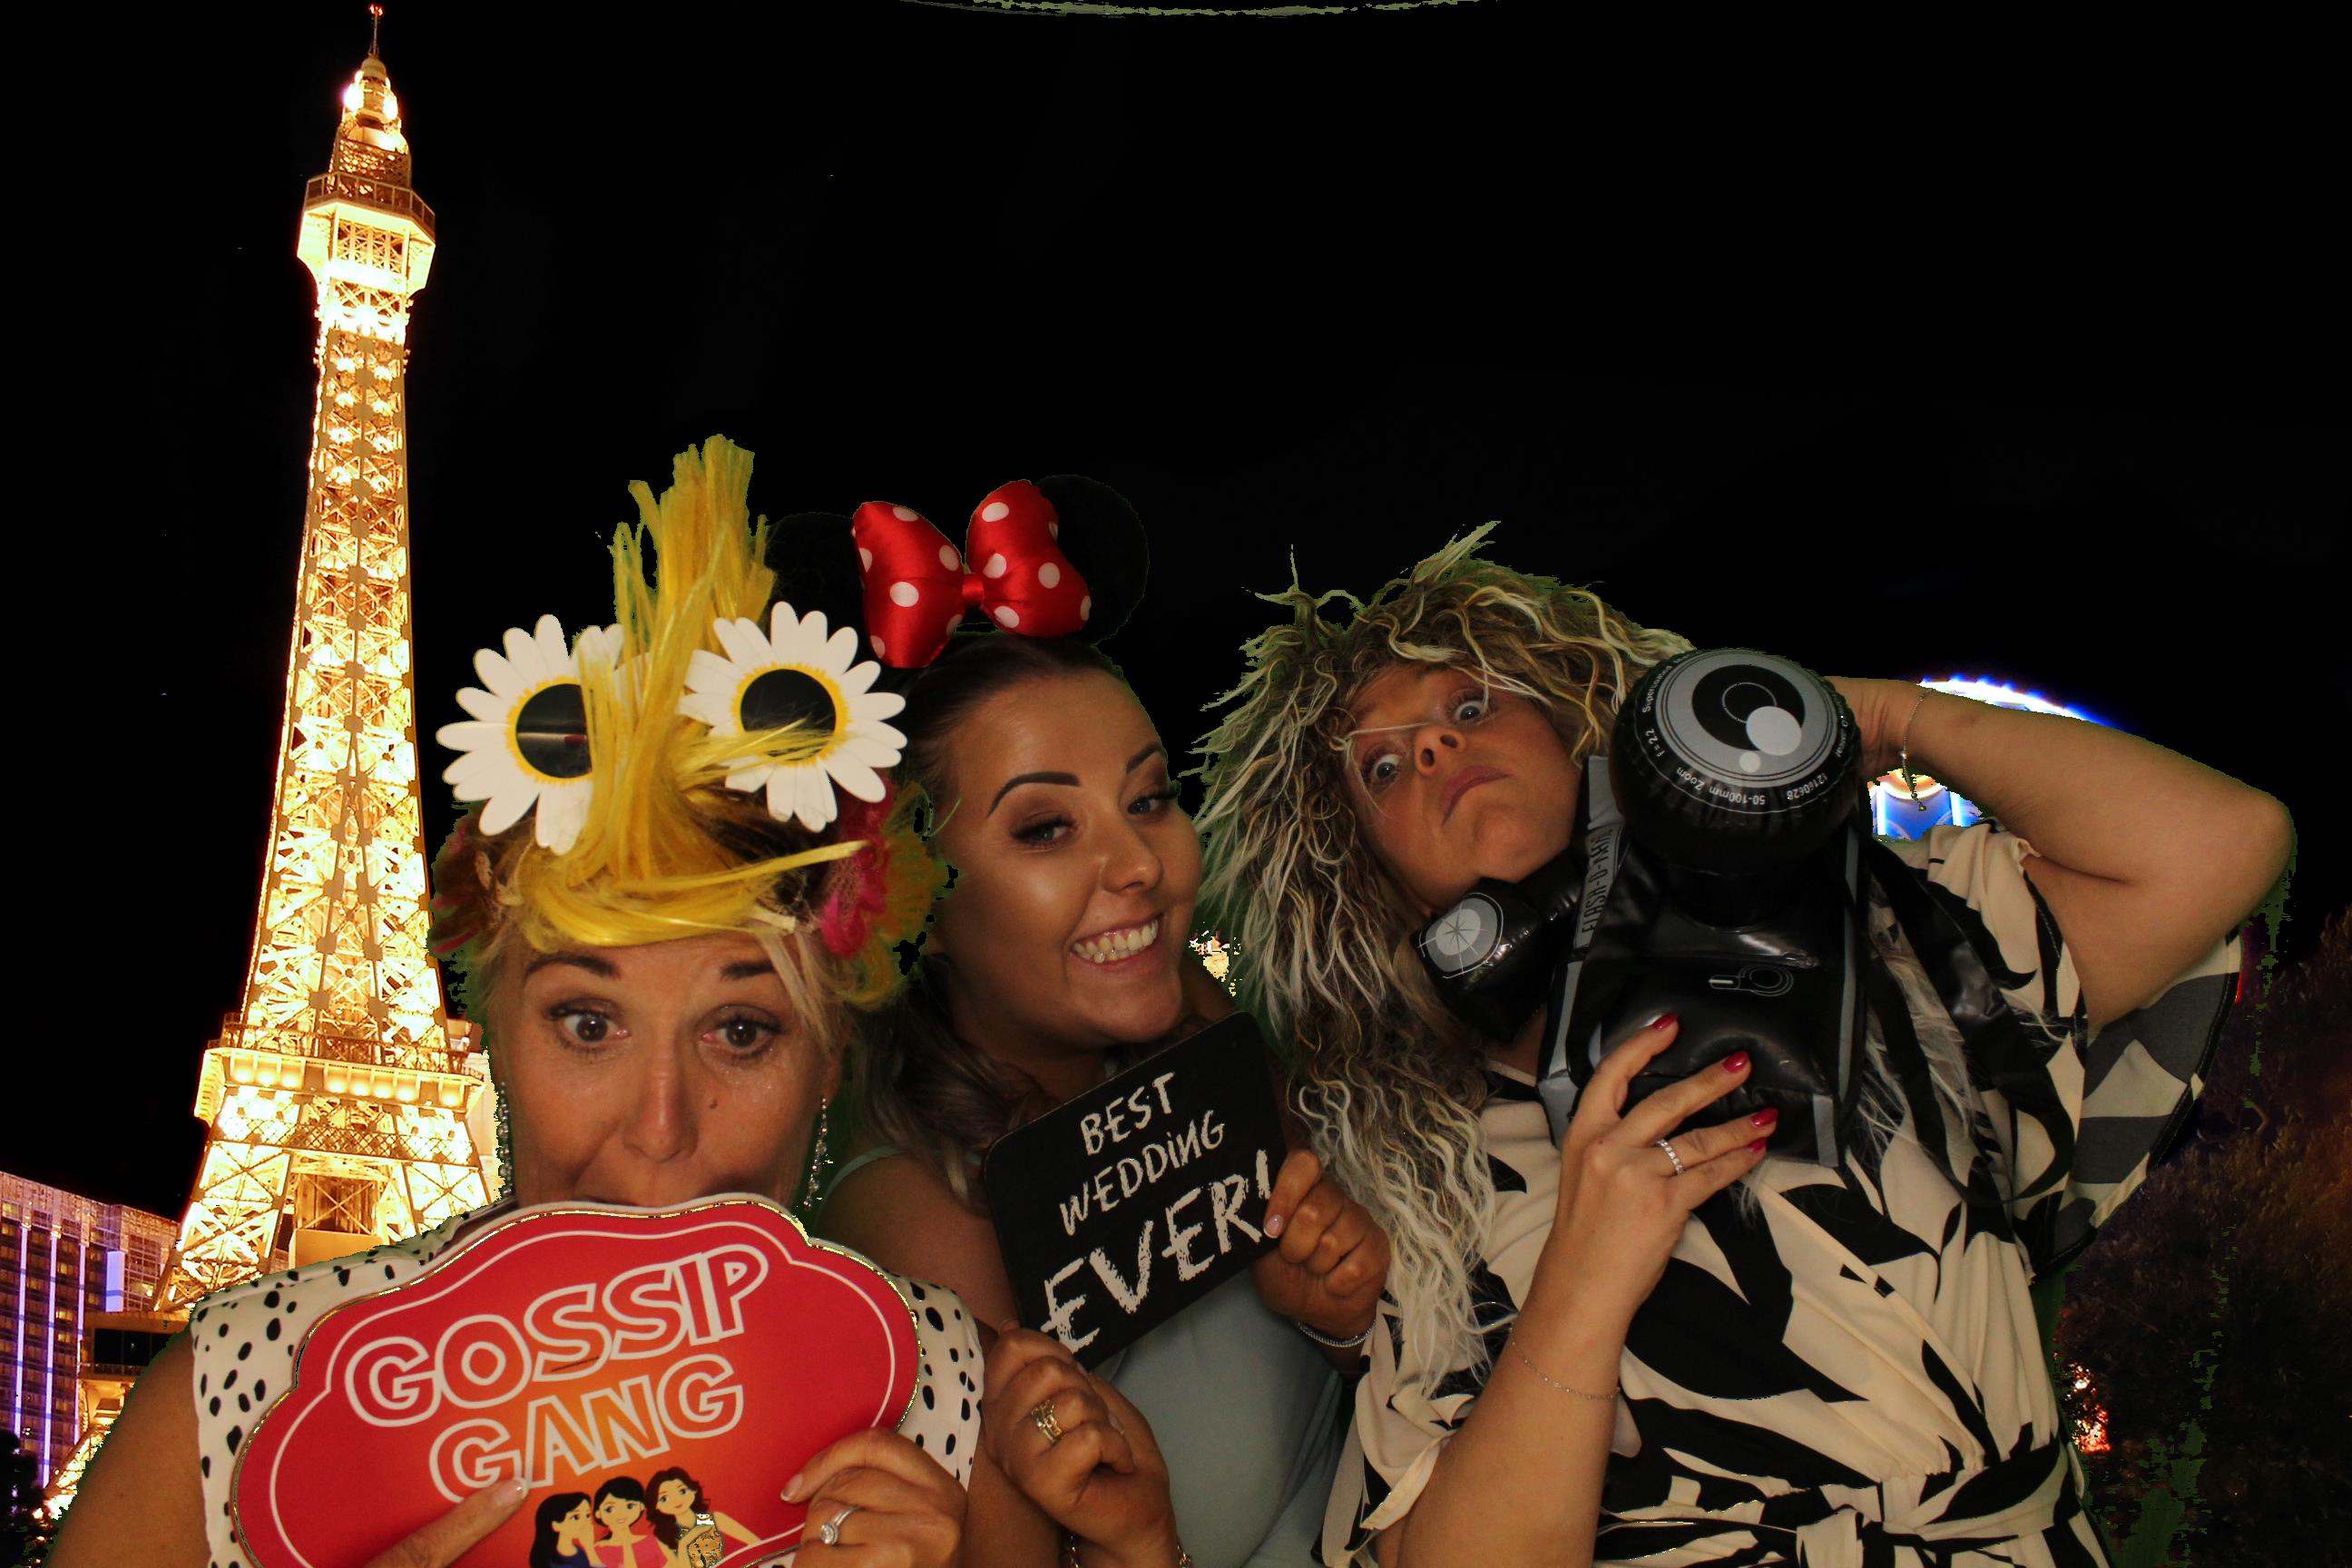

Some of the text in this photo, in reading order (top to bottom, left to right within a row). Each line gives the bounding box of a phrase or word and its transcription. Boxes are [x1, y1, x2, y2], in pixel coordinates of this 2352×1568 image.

[1676, 767, 1705, 791] Zoom
[1709, 786, 1766, 806] 50-100mm
[1080, 1072, 1175, 1156] BEST
[345, 1244, 769, 1427] GOSSIP
[429, 1354, 744, 1504] GANG
